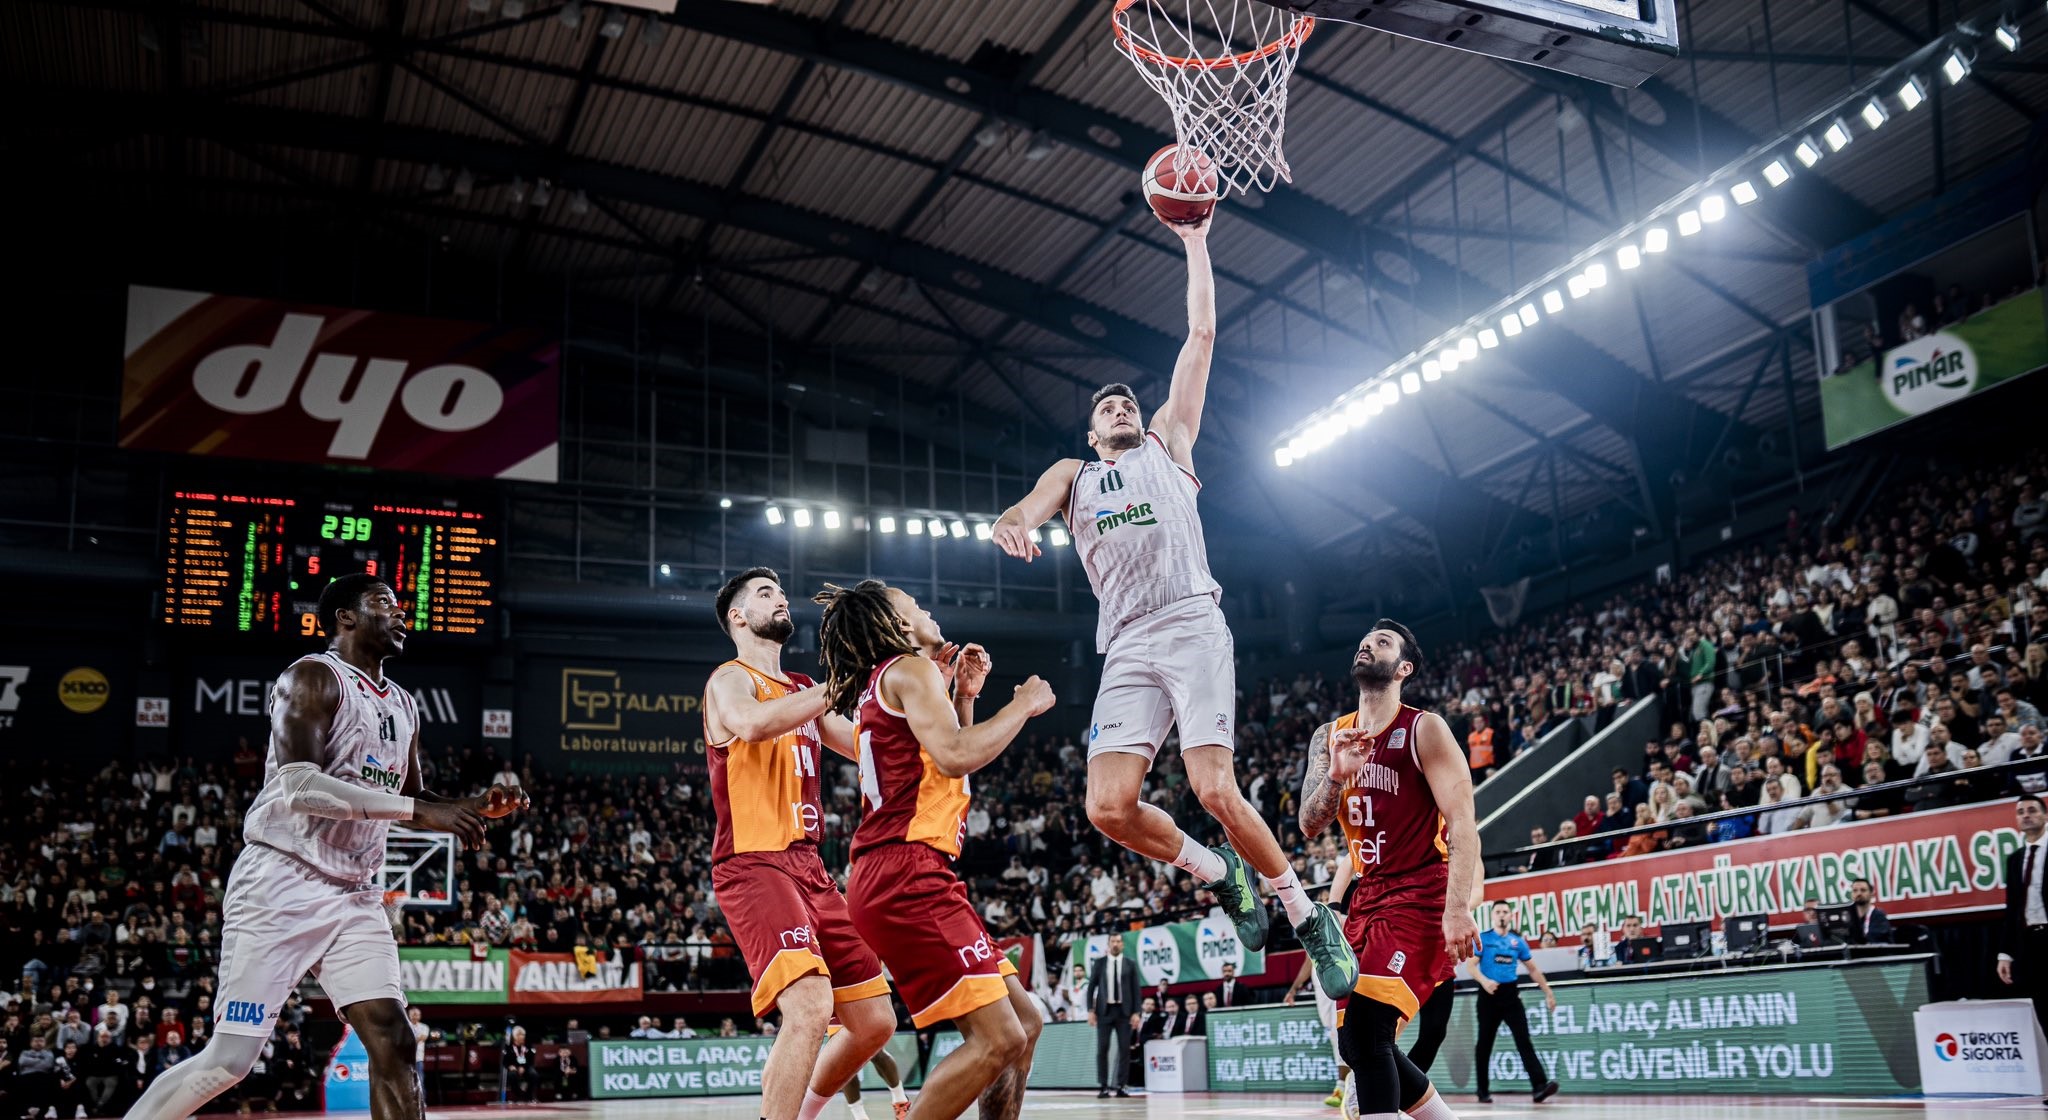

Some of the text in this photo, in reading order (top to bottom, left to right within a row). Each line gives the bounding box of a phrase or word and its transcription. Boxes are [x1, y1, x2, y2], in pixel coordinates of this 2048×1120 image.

[193, 312, 504, 460] dyo
[308, 556, 320, 574] 5
[366, 560, 377, 576] 3
[1102, 721, 1123, 731] JOXLY
[561, 735, 688, 754] Laboratuvarlar
[1347, 795, 1375, 827] 61
[1562, 880, 1648, 938] KEMAL
[1650, 854, 1779, 929] ATATÜRK
[1553, 1004, 1583, 1035] EL
[1587, 1000, 1661, 1039] ARAÇ
[1665, 990, 1798, 1031] ALMANIN
[1255, 1023, 1276, 1046] EL
[1277, 1019, 1321, 1049] ARAÇ
[602, 1044, 665, 1067] İKİNCİ
[667, 1047, 694, 1065] EL
[696, 1045, 752, 1066] ARAÇ
[1562, 1049, 1596, 1080] VE
[1600, 1040, 1747, 1080] GÜVENİLİR
[1750, 1042, 1834, 1079] YOLU
[603, 1071, 672, 1091] KOLAY
[674, 1071, 703, 1089] VE
[1215, 1057, 1260, 1082] KOLAY
[1262, 1056, 1283, 1081] VE
